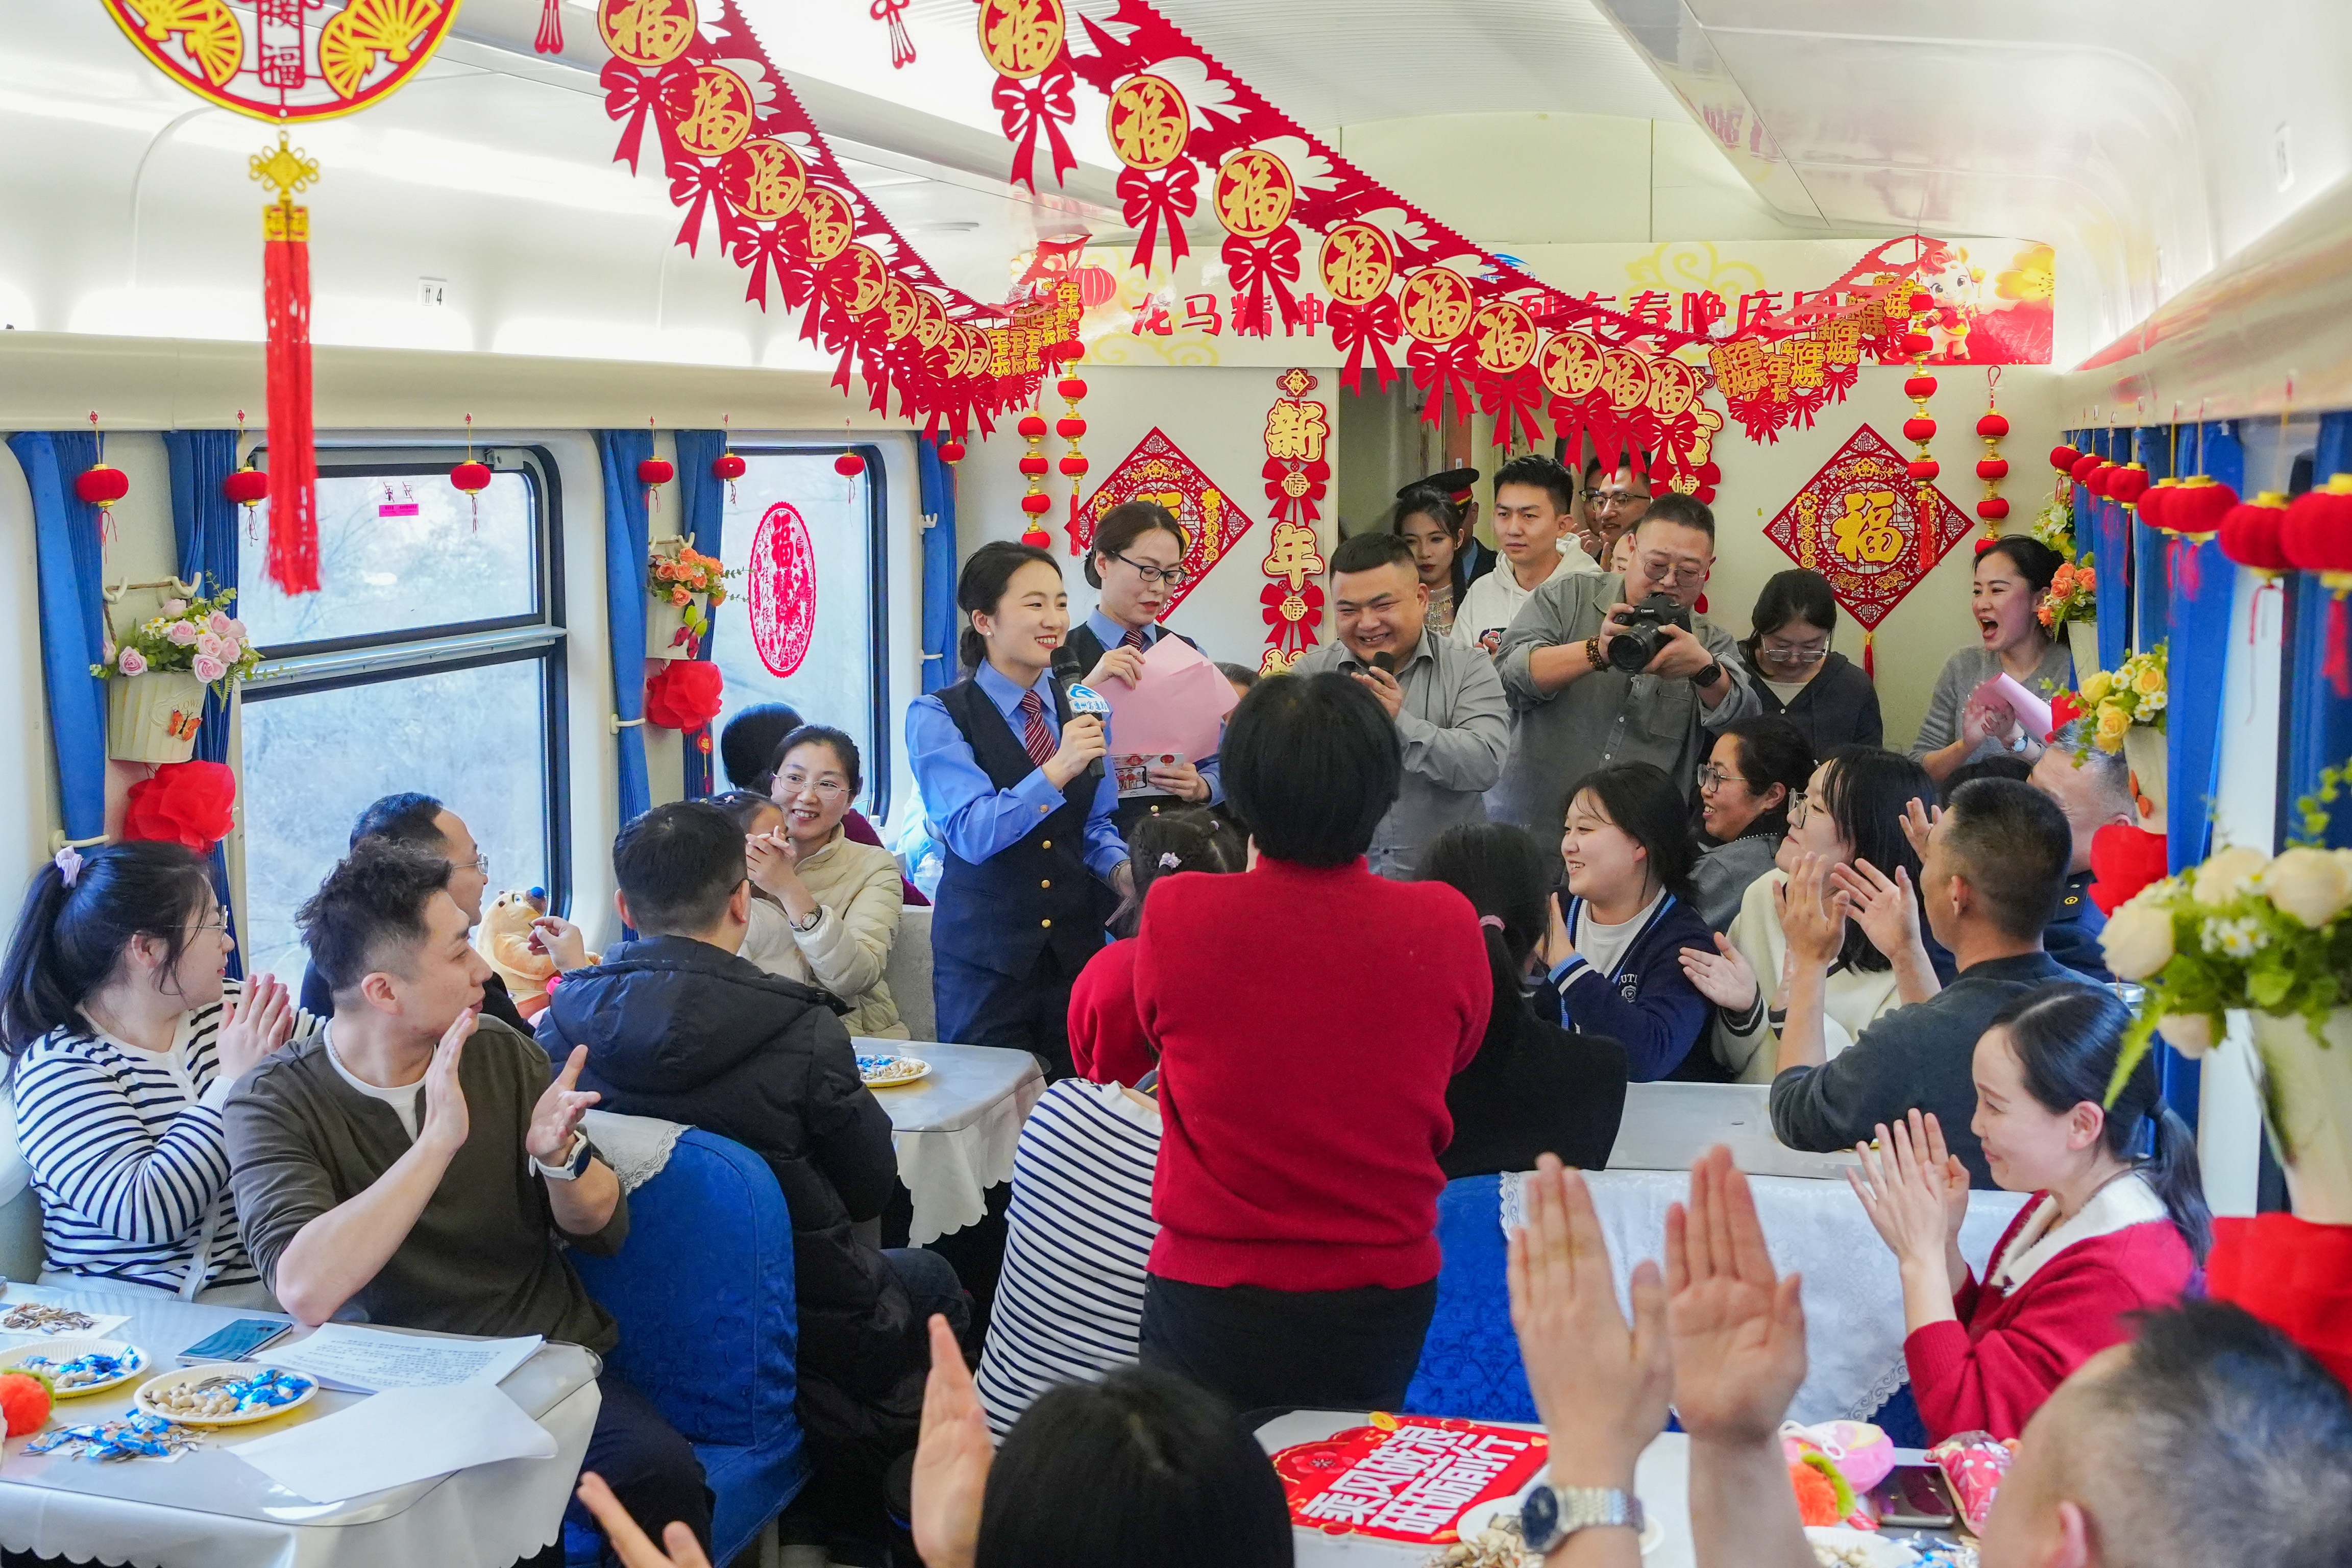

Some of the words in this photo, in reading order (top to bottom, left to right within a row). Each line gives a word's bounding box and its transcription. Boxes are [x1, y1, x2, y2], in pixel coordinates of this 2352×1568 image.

[989, 0, 1054, 70] 福
[676, 75, 747, 148] 福
[1116, 84, 1181, 161] 福
[743, 146, 800, 213] 福
[1221, 157, 1287, 230] 福
[436, 287, 442, 306] 4
[1327, 230, 1388, 300] 福
[1407, 271, 1467, 338] 福
[1477, 306, 1532, 369] 福
[1289, 374, 1306, 390] 福
[1547, 337, 1598, 394] 福
[1602, 354, 1646, 407] 福
[1646, 361, 1693, 413] 福
[1283, 474, 1308, 496] 福
[771, 512, 794, 569] 福
[1831, 490, 1904, 563] 福
[1283, 596, 1307, 620] 福
[1300, 1425, 1466, 1525] 乘风破浪
[1367, 1434, 1529, 1534] 砥砺前行
